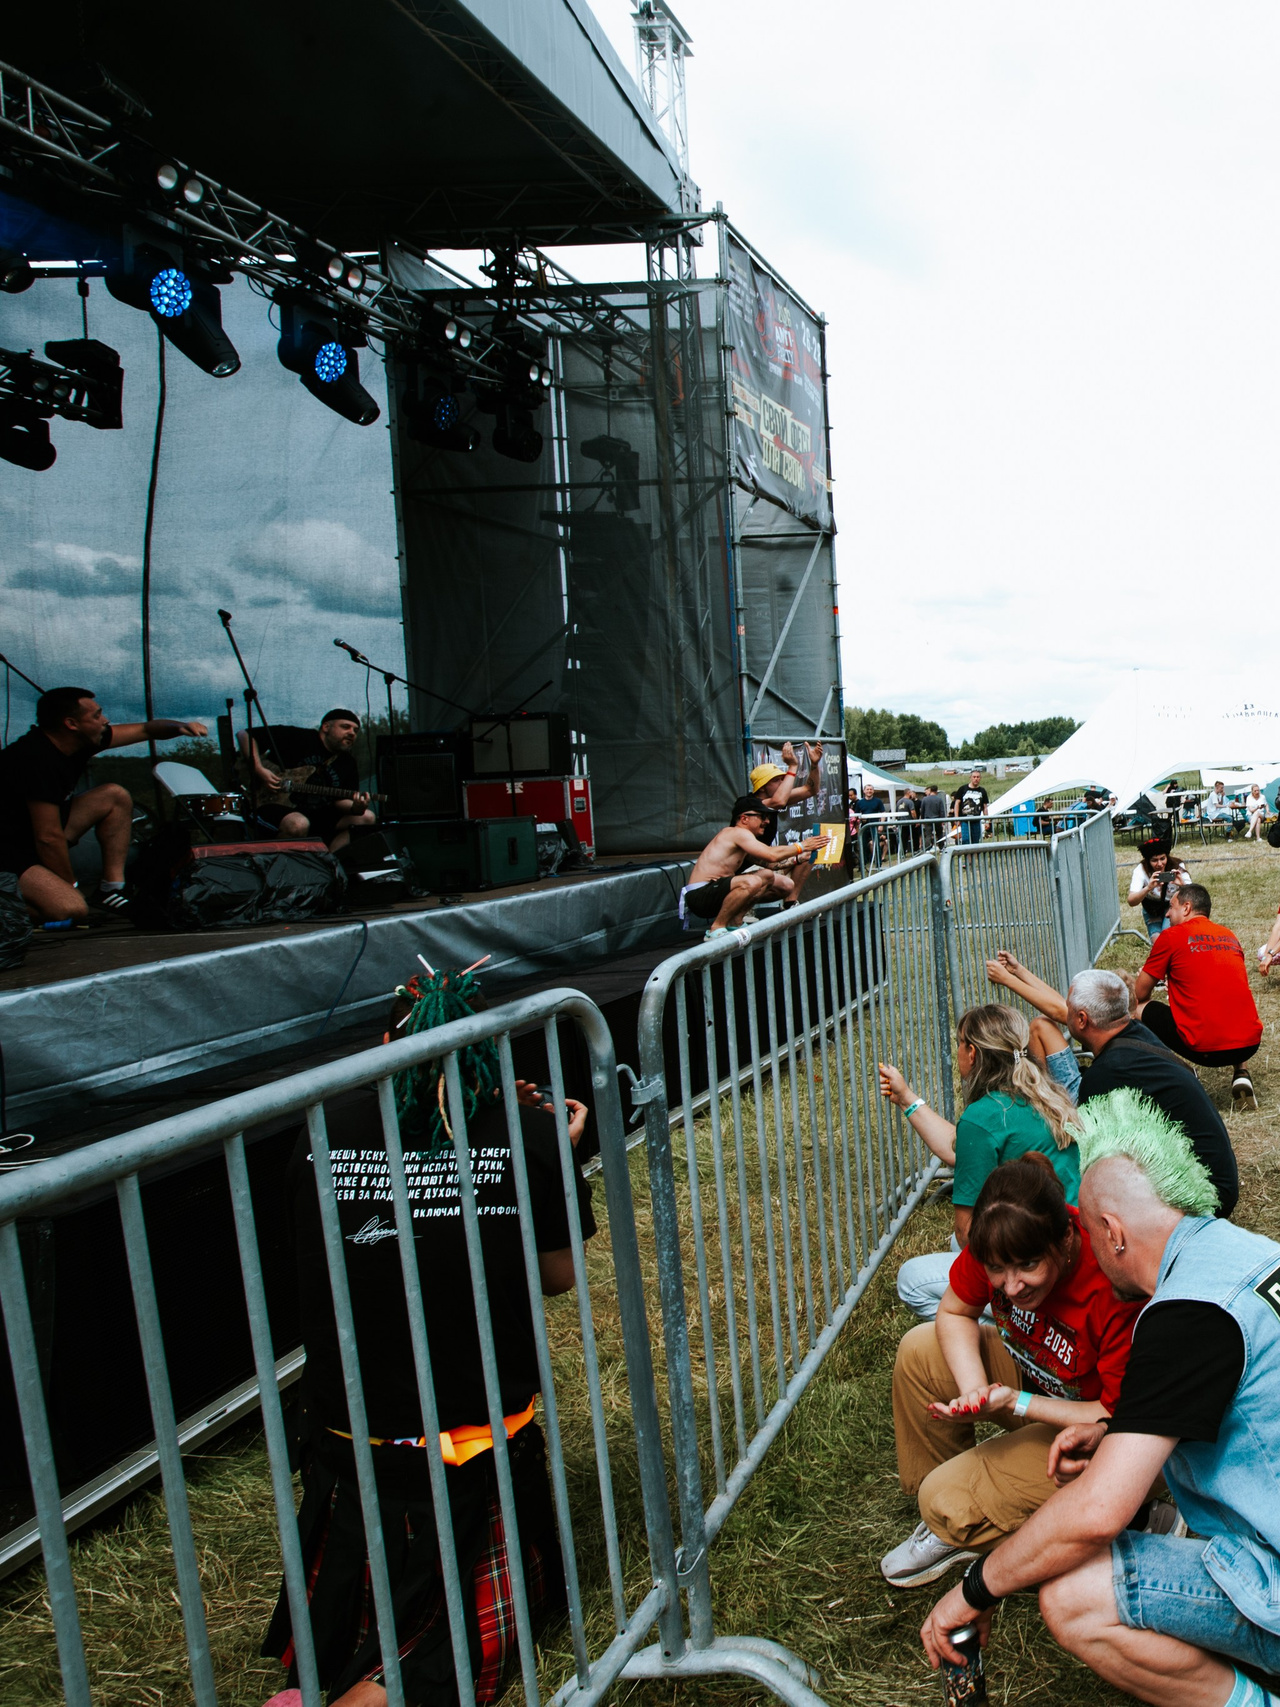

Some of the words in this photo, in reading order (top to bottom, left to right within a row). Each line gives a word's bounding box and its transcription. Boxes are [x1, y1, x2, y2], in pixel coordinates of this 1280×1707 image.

[762, 399, 788, 444] СВОЙ
[790, 422, 810, 453] ФЕСТ
[762, 438, 780, 475] ДЛЯ
[480, 1147, 512, 1159] СМЕРТ
[331, 1162, 391, 1175] ОБСТВЕННО
[478, 1159, 506, 1171] РУКИ,
[360, 1176, 368, 1187] В
[370, 1176, 392, 1189] АДУ
[446, 1174, 461, 1185] МО
[334, 1189, 355, 1201] ЕБЯ
[358, 1189, 370, 1200] ЗА
[373, 1188, 422, 1202] ПАДИЕ
[413, 1205, 461, 1219] ВКЛЮЧАЙ
[1011, 1312, 1033, 1335] PARTY
[1044, 1326, 1074, 1366] 2025
